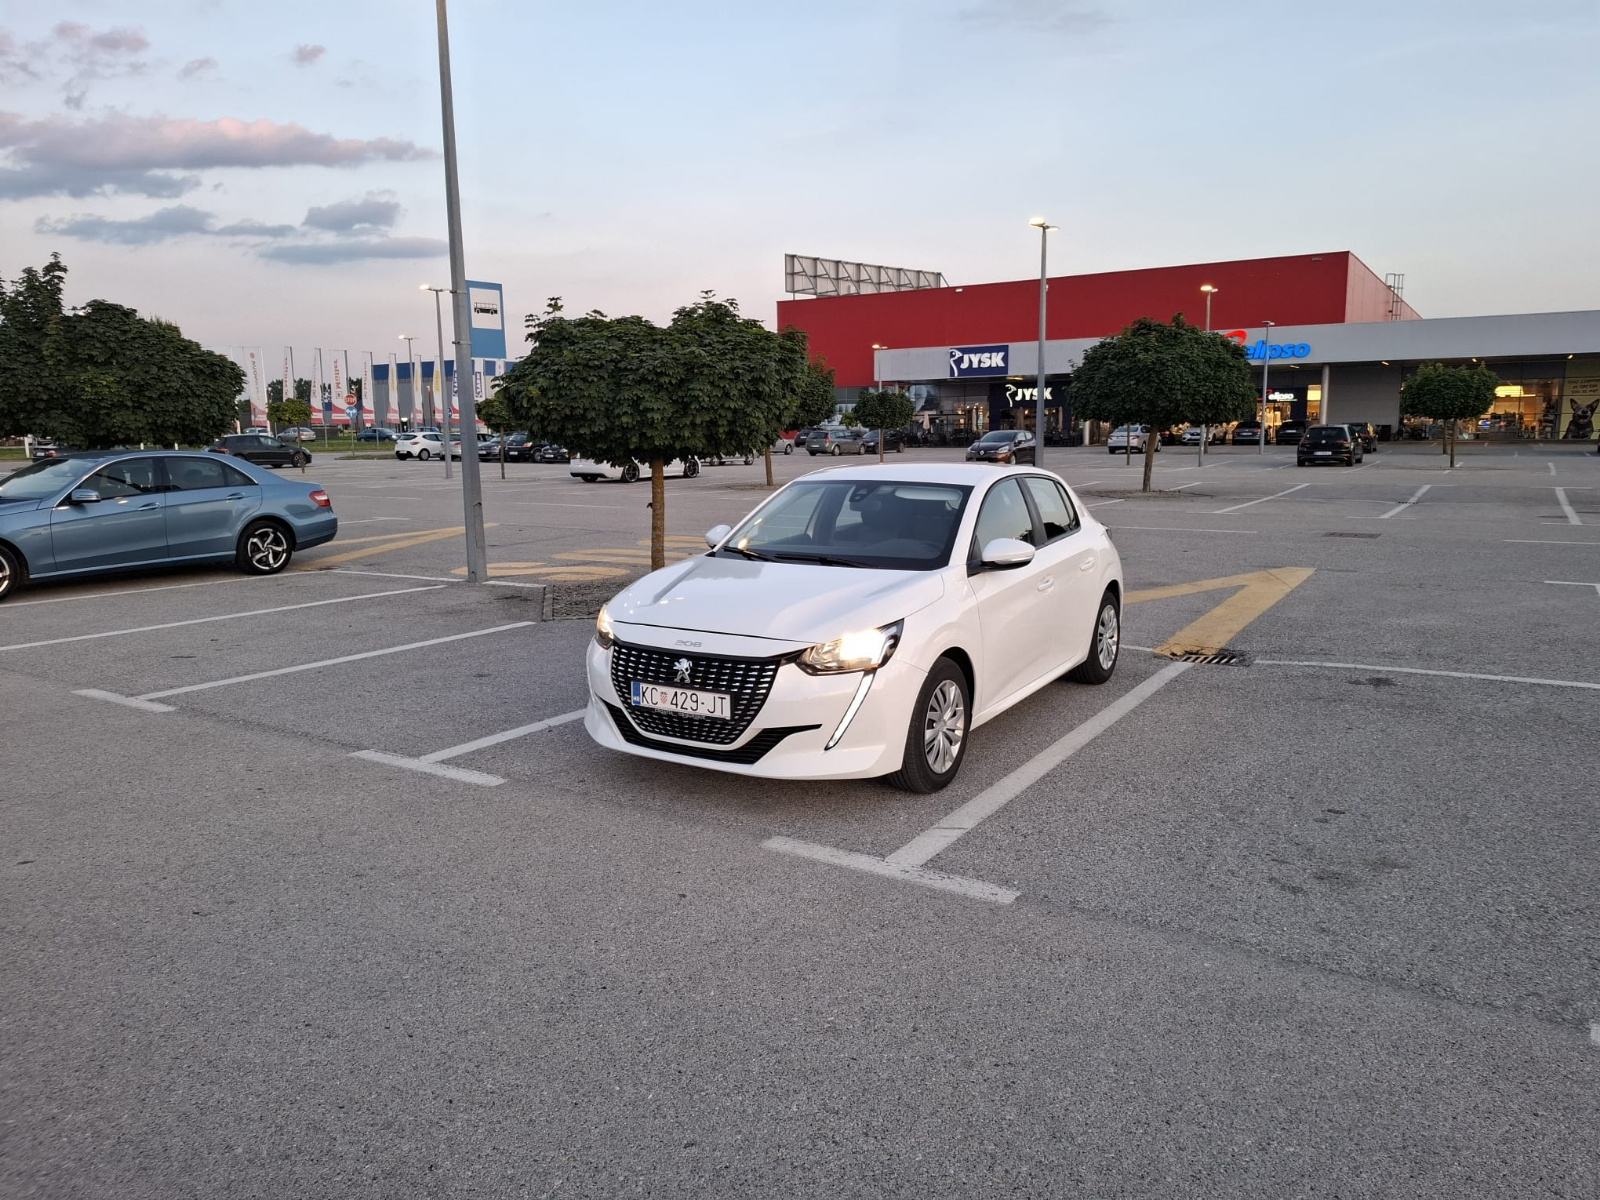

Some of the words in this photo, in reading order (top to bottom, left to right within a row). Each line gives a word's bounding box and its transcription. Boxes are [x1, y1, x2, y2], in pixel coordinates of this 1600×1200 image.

[960, 352, 1006, 369] JYSK
[1268, 391, 1294, 402] elipso
[675, 639, 702, 648] 208
[641, 686, 658, 705] KC
[670, 690, 726, 715] 429-JT
